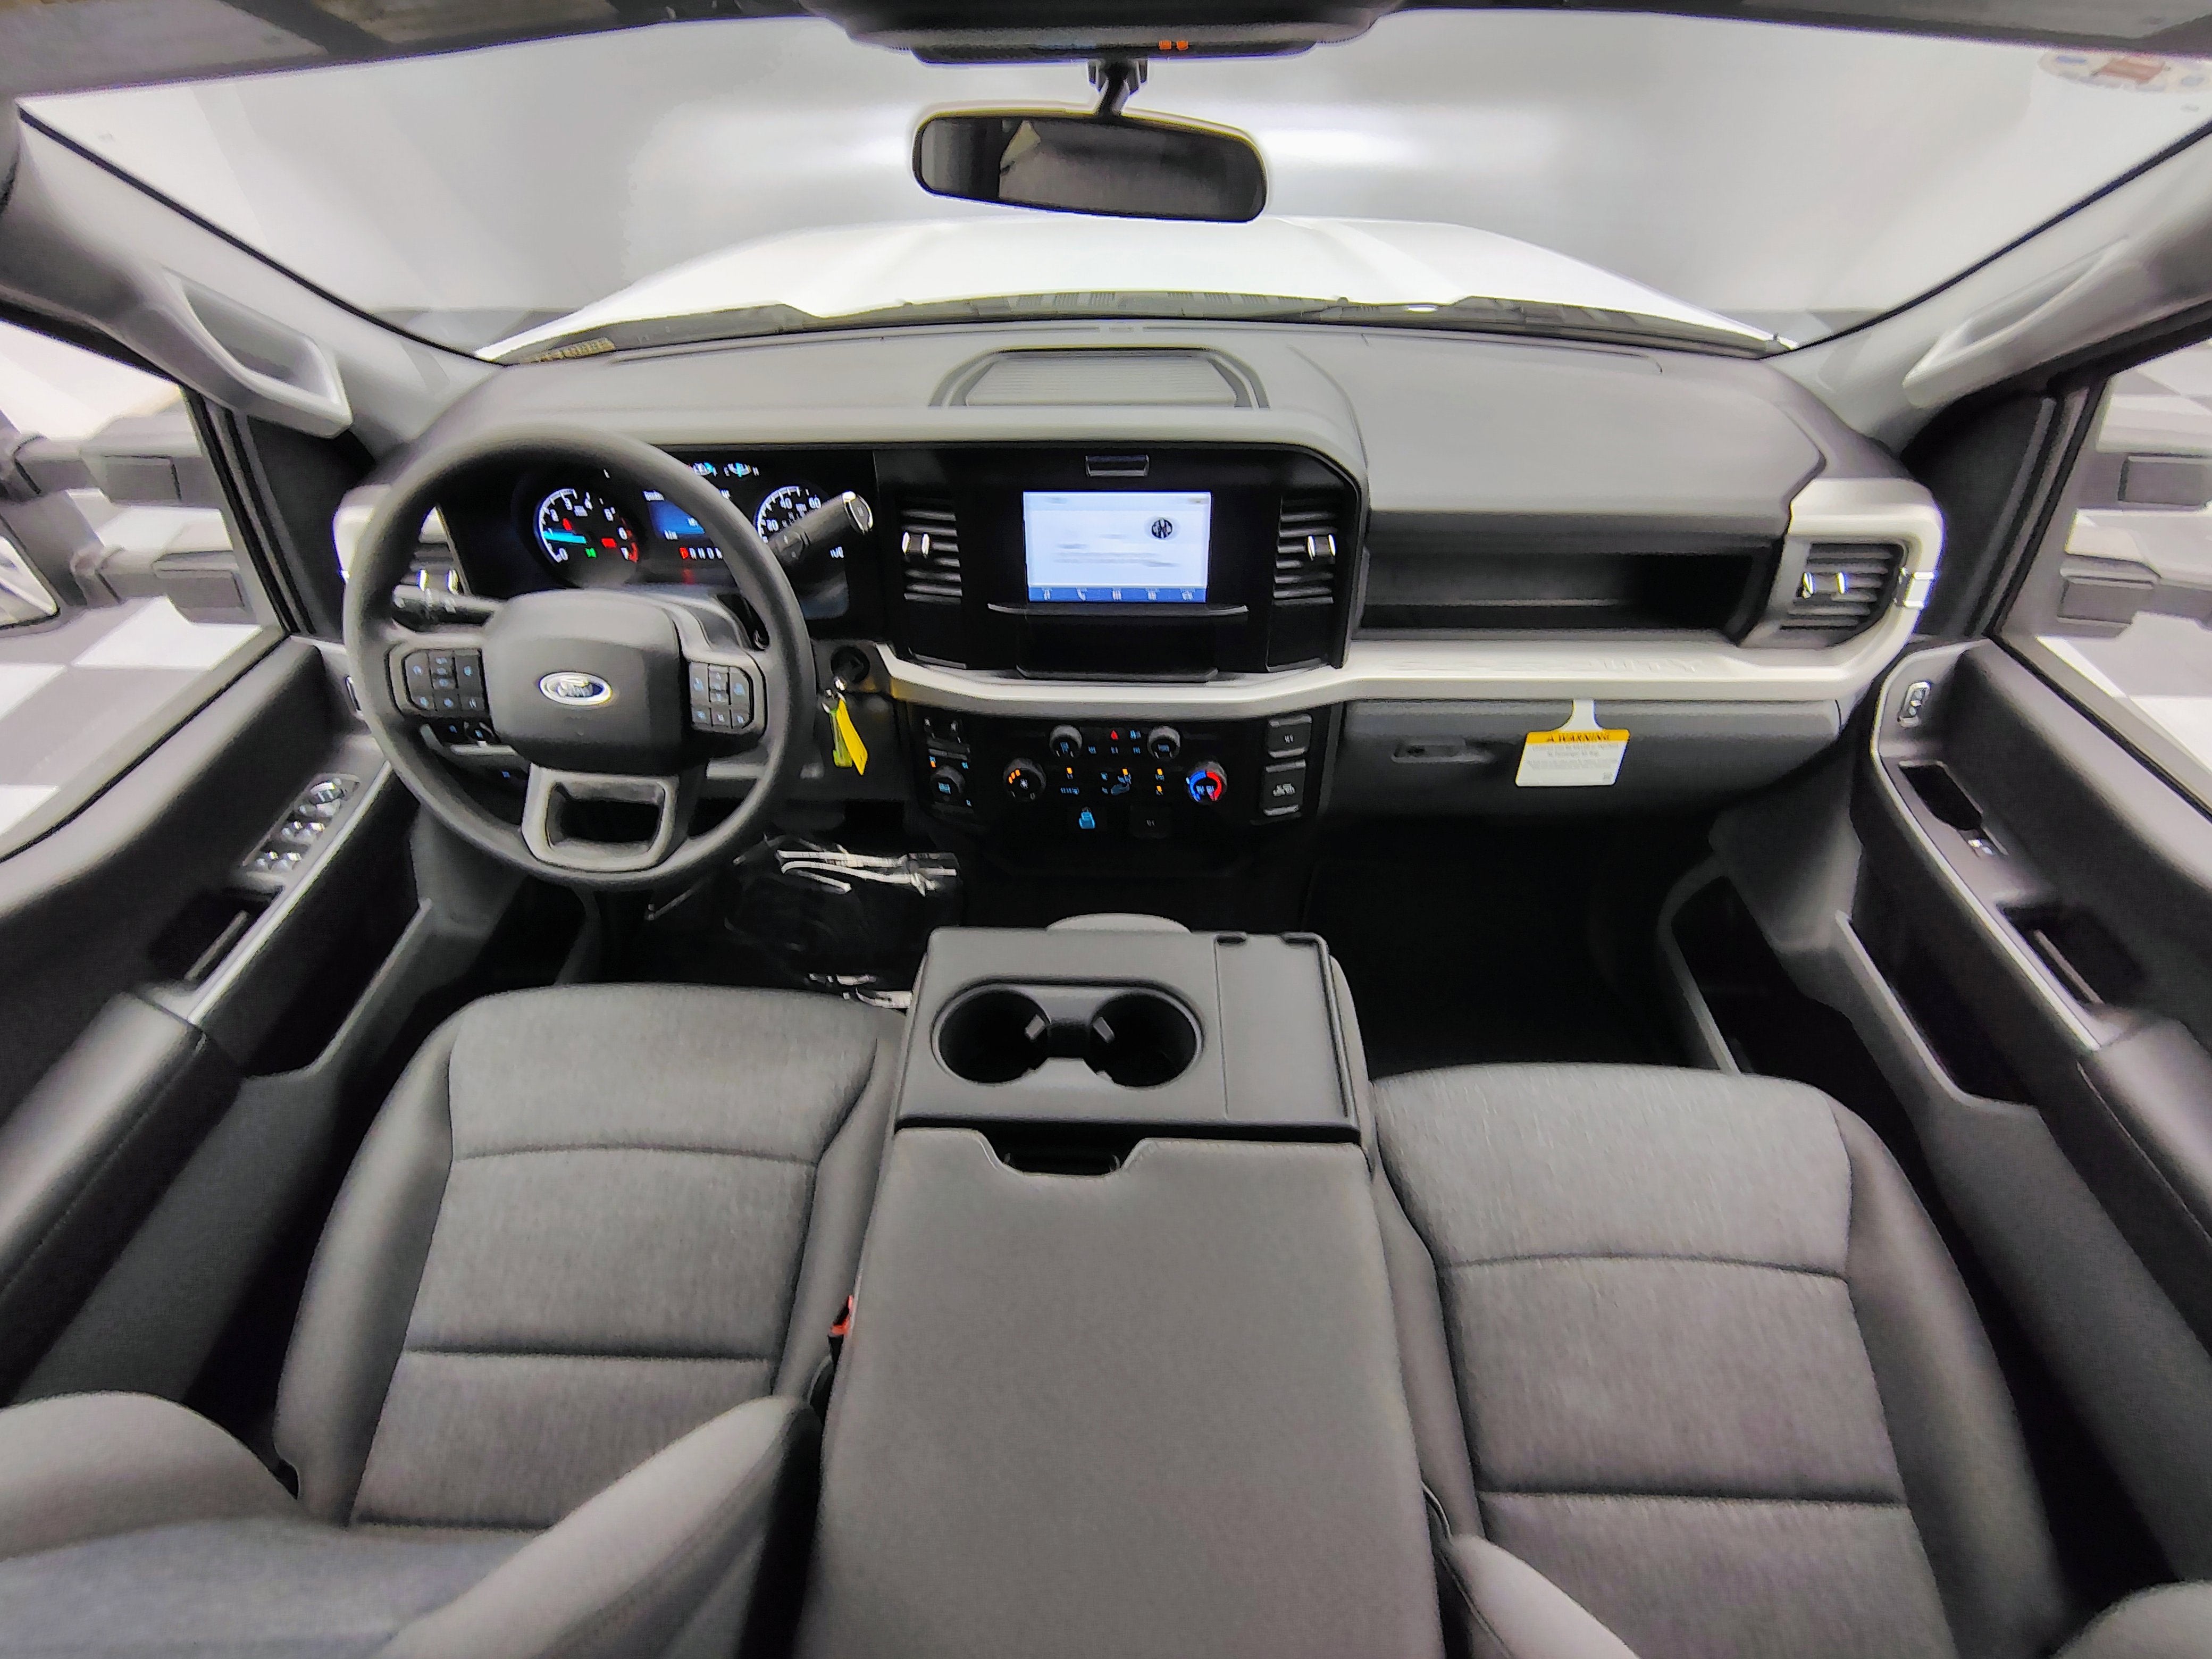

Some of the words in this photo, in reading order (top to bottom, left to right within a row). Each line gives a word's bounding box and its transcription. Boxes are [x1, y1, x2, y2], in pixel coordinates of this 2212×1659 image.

[808, 497, 821, 509] 60
[559, 548, 568, 561] 0
[1559, 733, 1610, 742] WARNING
